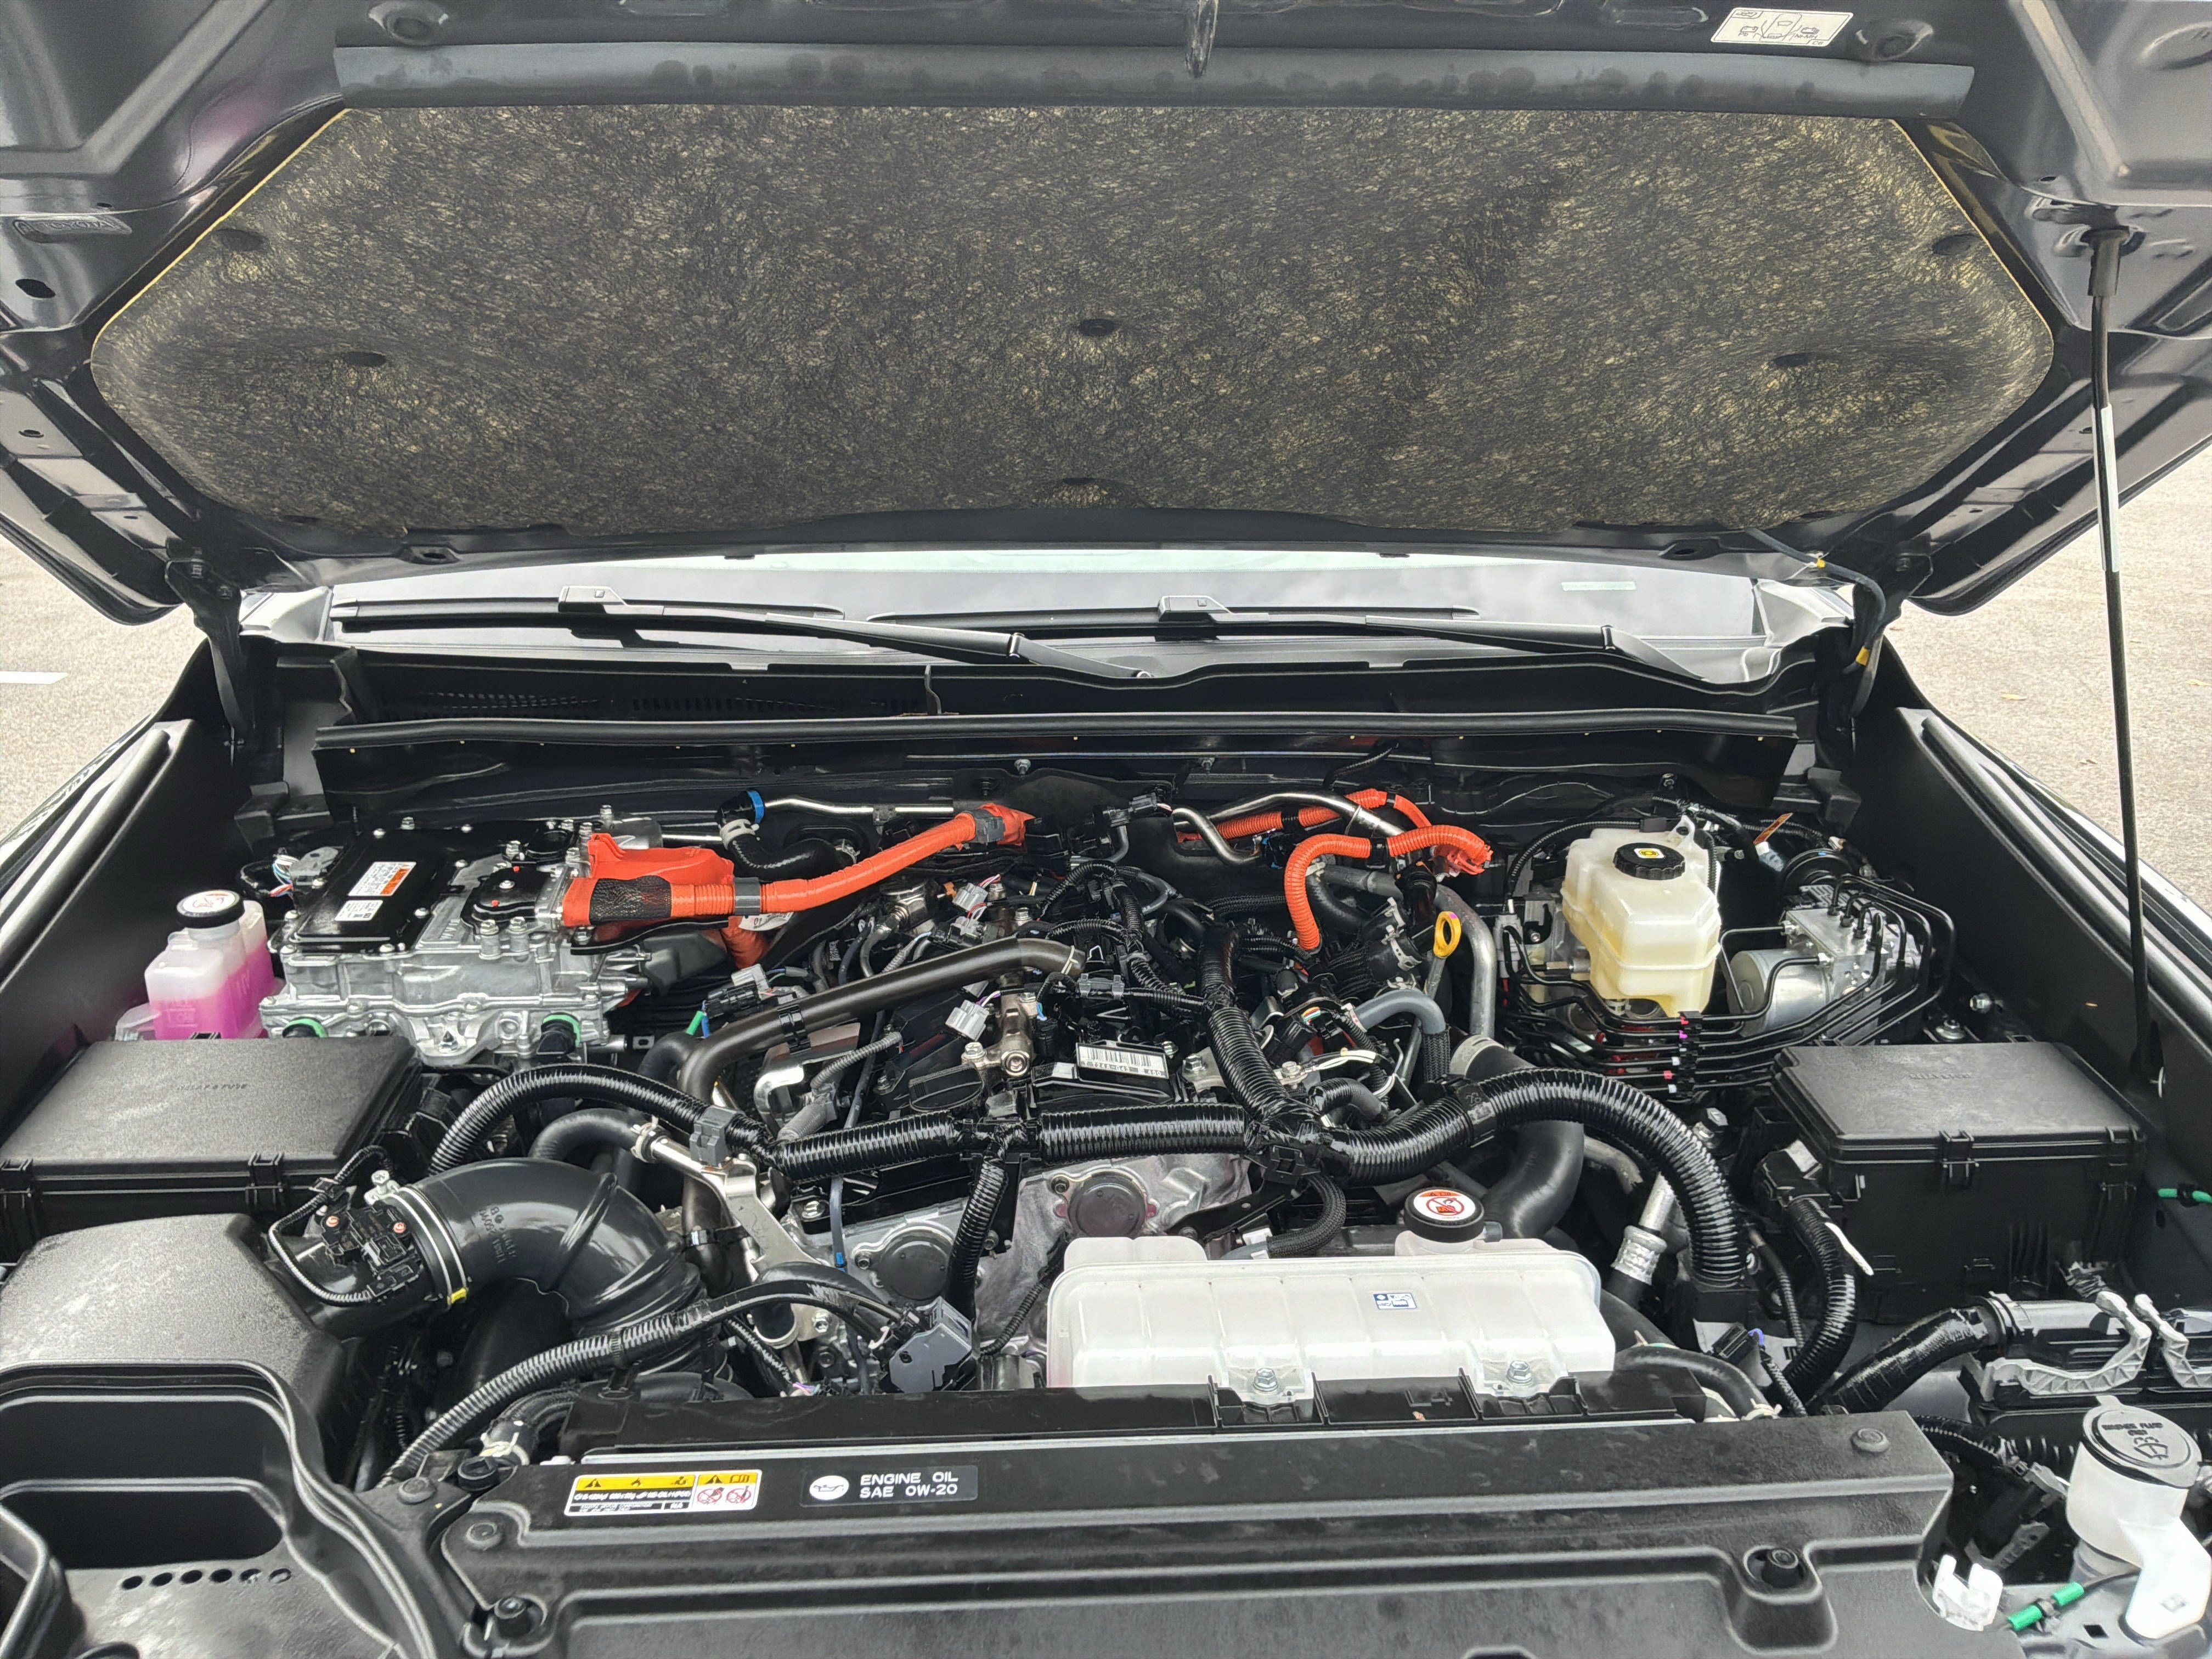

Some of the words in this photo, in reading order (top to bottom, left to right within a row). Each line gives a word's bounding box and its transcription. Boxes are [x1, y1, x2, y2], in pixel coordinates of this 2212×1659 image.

[38, 221, 115, 230] TOYOTA
[860, 1471, 922, 1486] ENGINE
[932, 1471, 959, 1483] OIL
[859, 1486, 895, 1499] SAE
[905, 1483, 958, 1497] 0W-20
